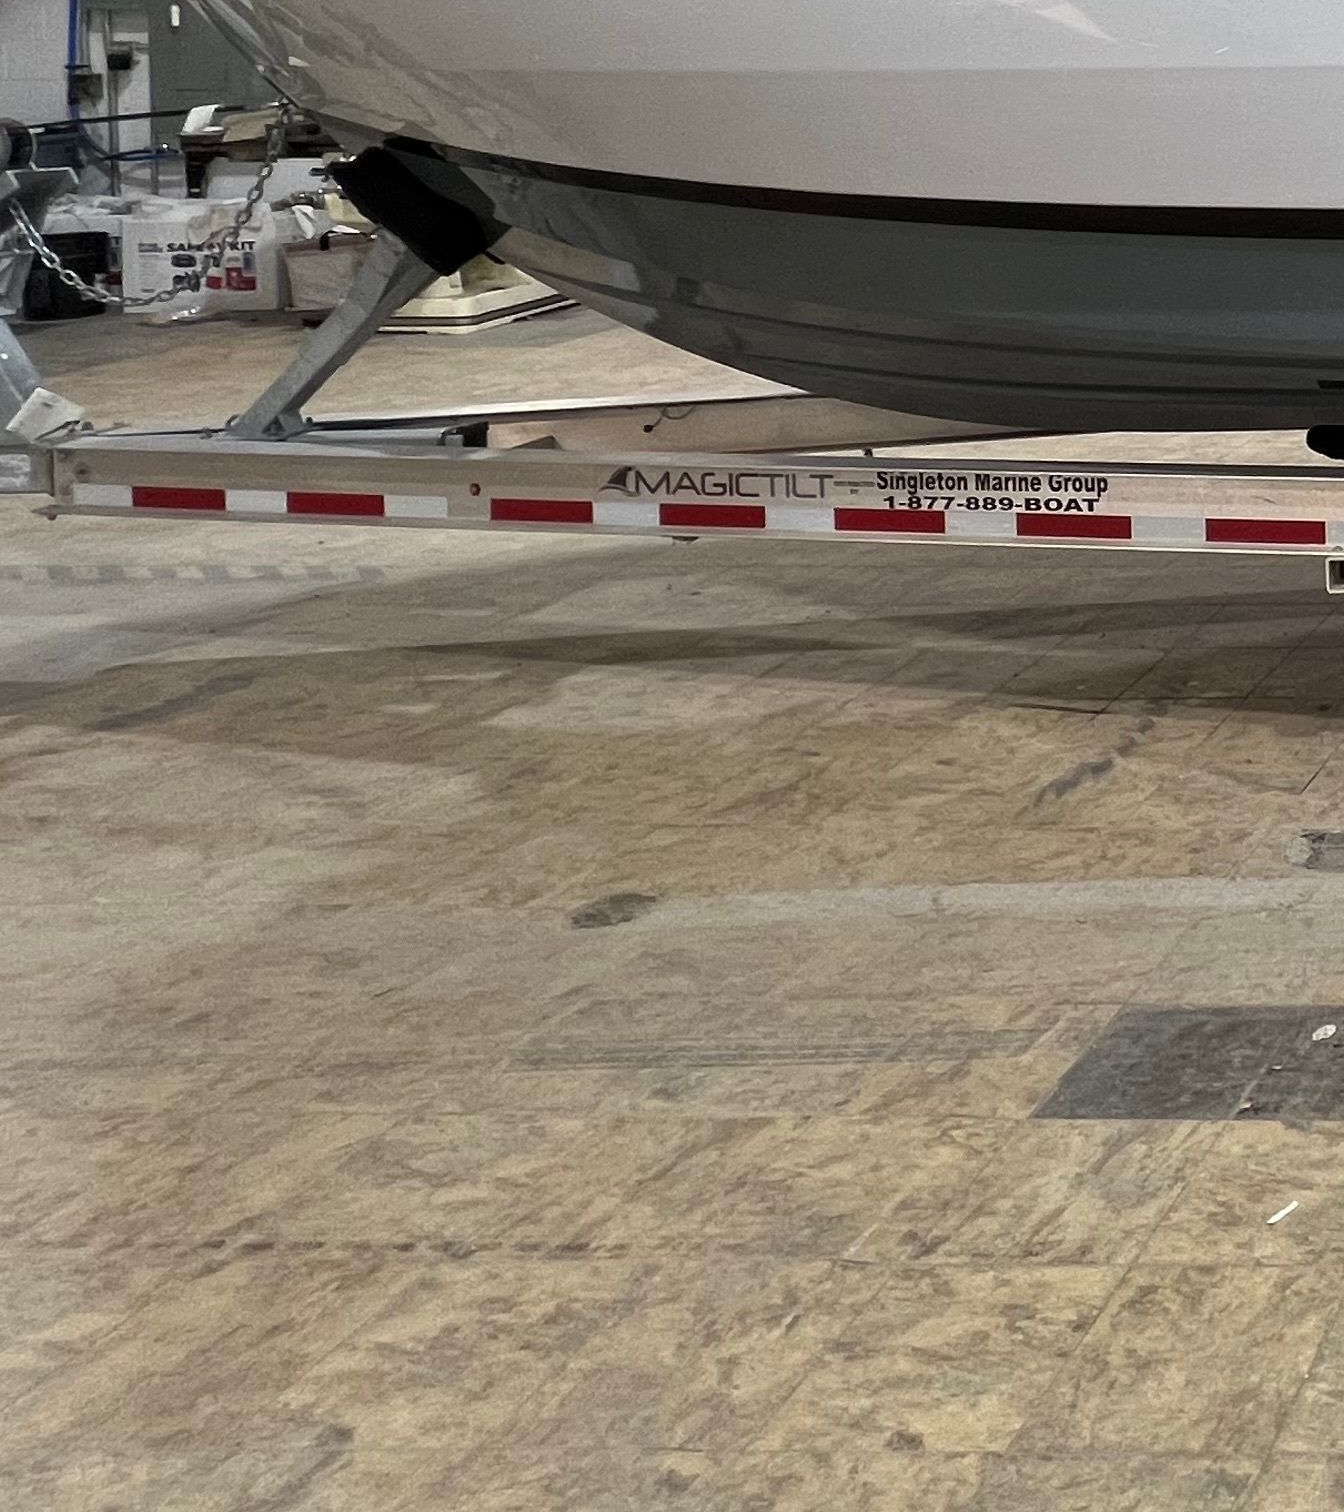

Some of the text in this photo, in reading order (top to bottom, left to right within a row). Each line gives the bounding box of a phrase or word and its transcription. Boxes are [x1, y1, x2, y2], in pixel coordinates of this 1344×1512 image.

[634, 470, 834, 499] MAGICTILT
[876, 471, 1108, 498] Singleton Marine Group
[884, 495, 1099, 512] 1-877-889-BOAT
